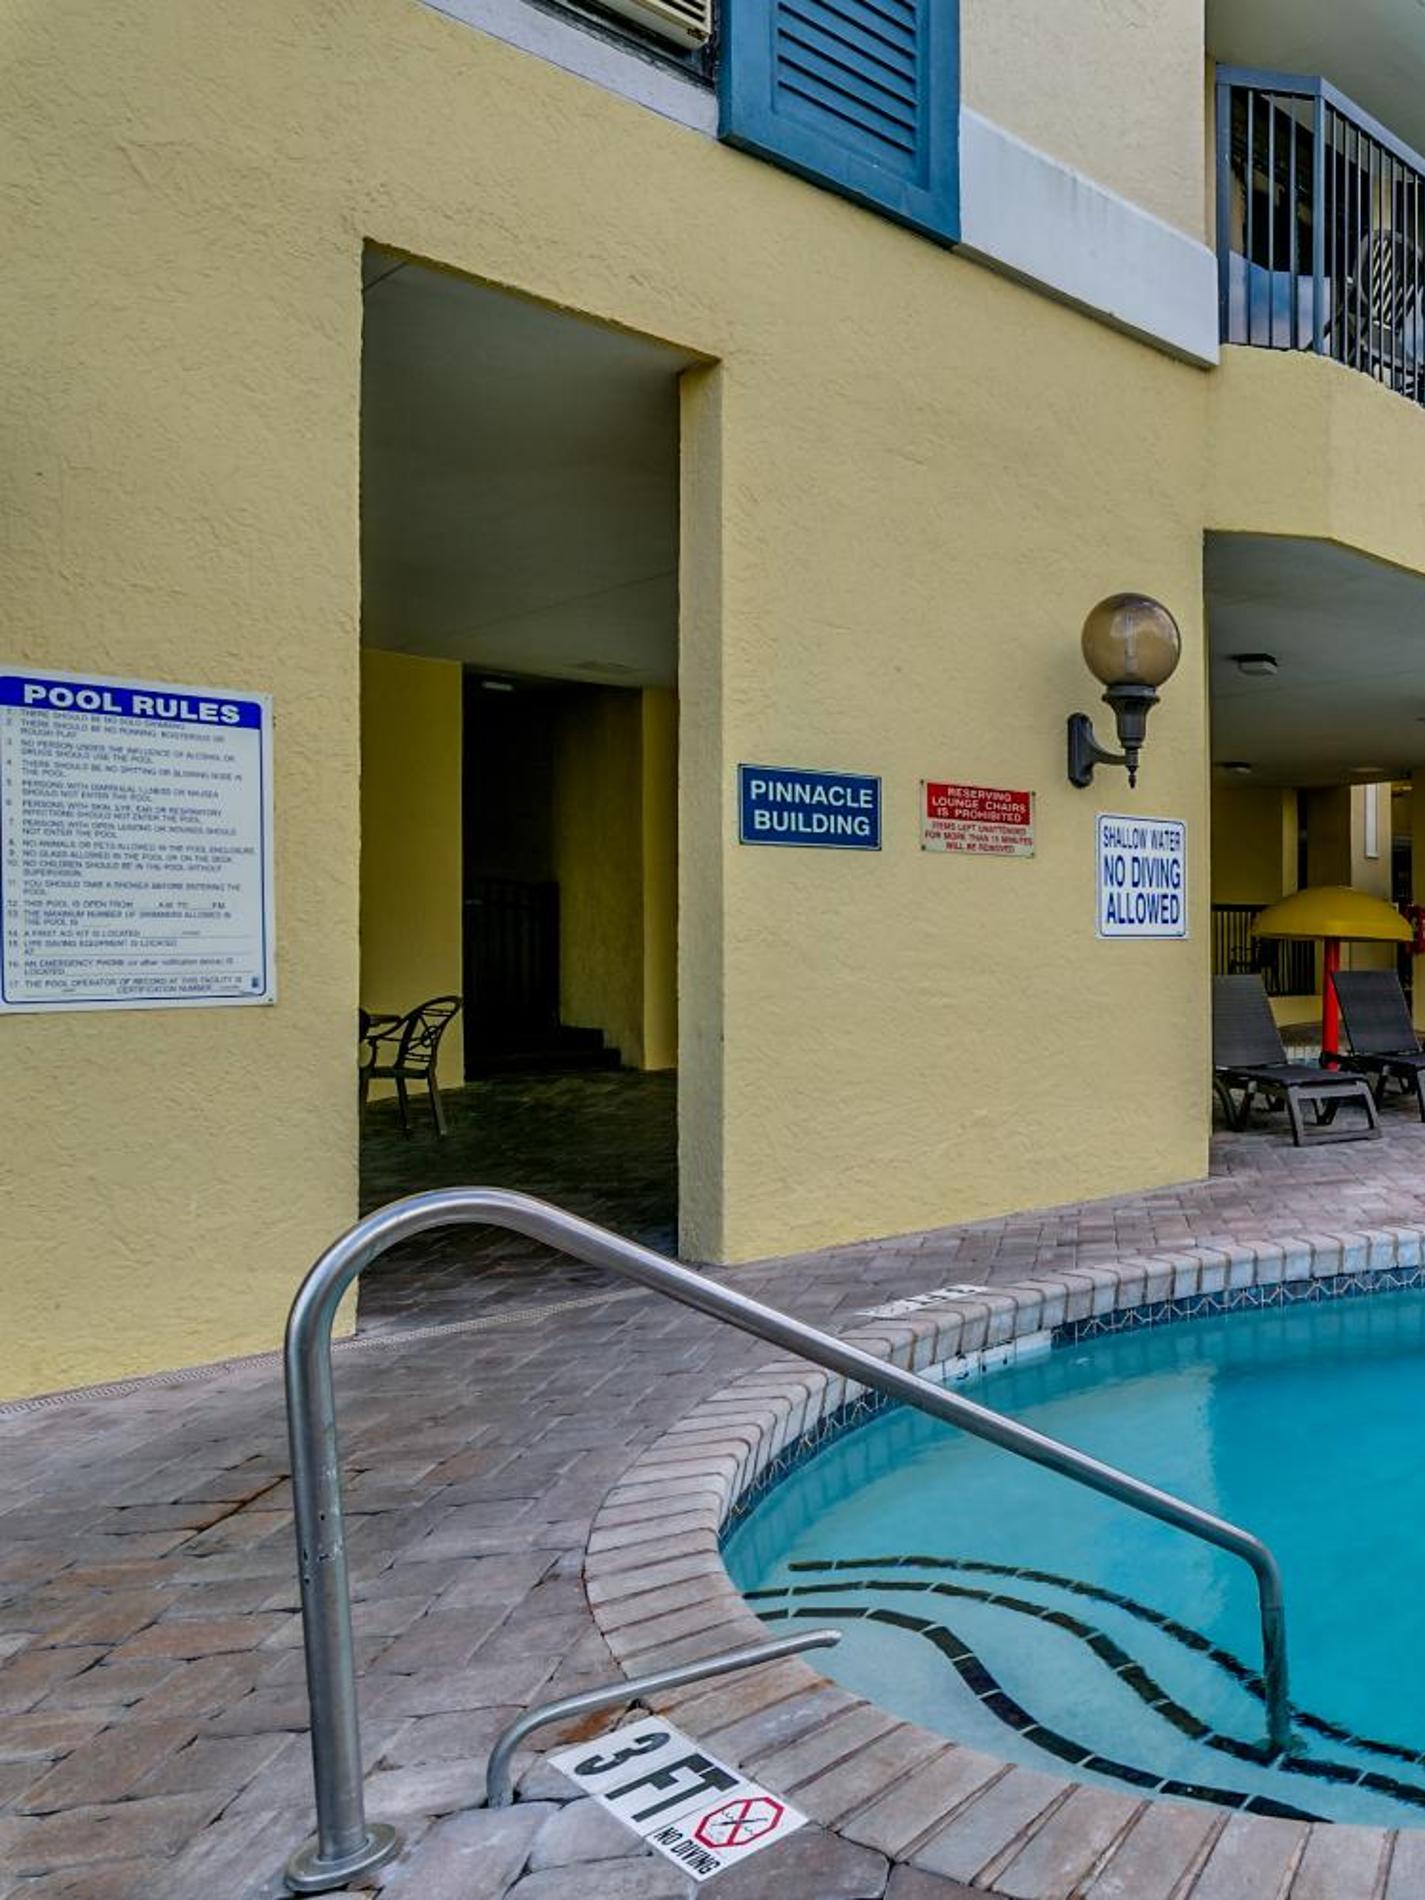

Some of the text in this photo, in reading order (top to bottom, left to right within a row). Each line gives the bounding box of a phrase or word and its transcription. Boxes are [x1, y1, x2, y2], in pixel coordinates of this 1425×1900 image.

[24, 684, 240, 724] POOL RULES
[751, 780, 873, 808] PINNACLE
[932, 797, 1026, 813] LOUNGE CHAIRS
[948, 788, 1011, 802] RESERVING
[754, 809, 870, 836] BUILDING
[937, 807, 1021, 822] IS PROHIBITED
[1104, 826, 1180, 851] SHALLOW WATER
[1104, 855, 1180, 889] NO DIVING
[1107, 893, 1180, 924] ALLOWED
[574, 1732, 740, 1822] 3 FT
[654, 1827, 720, 1874] NO DIVING
